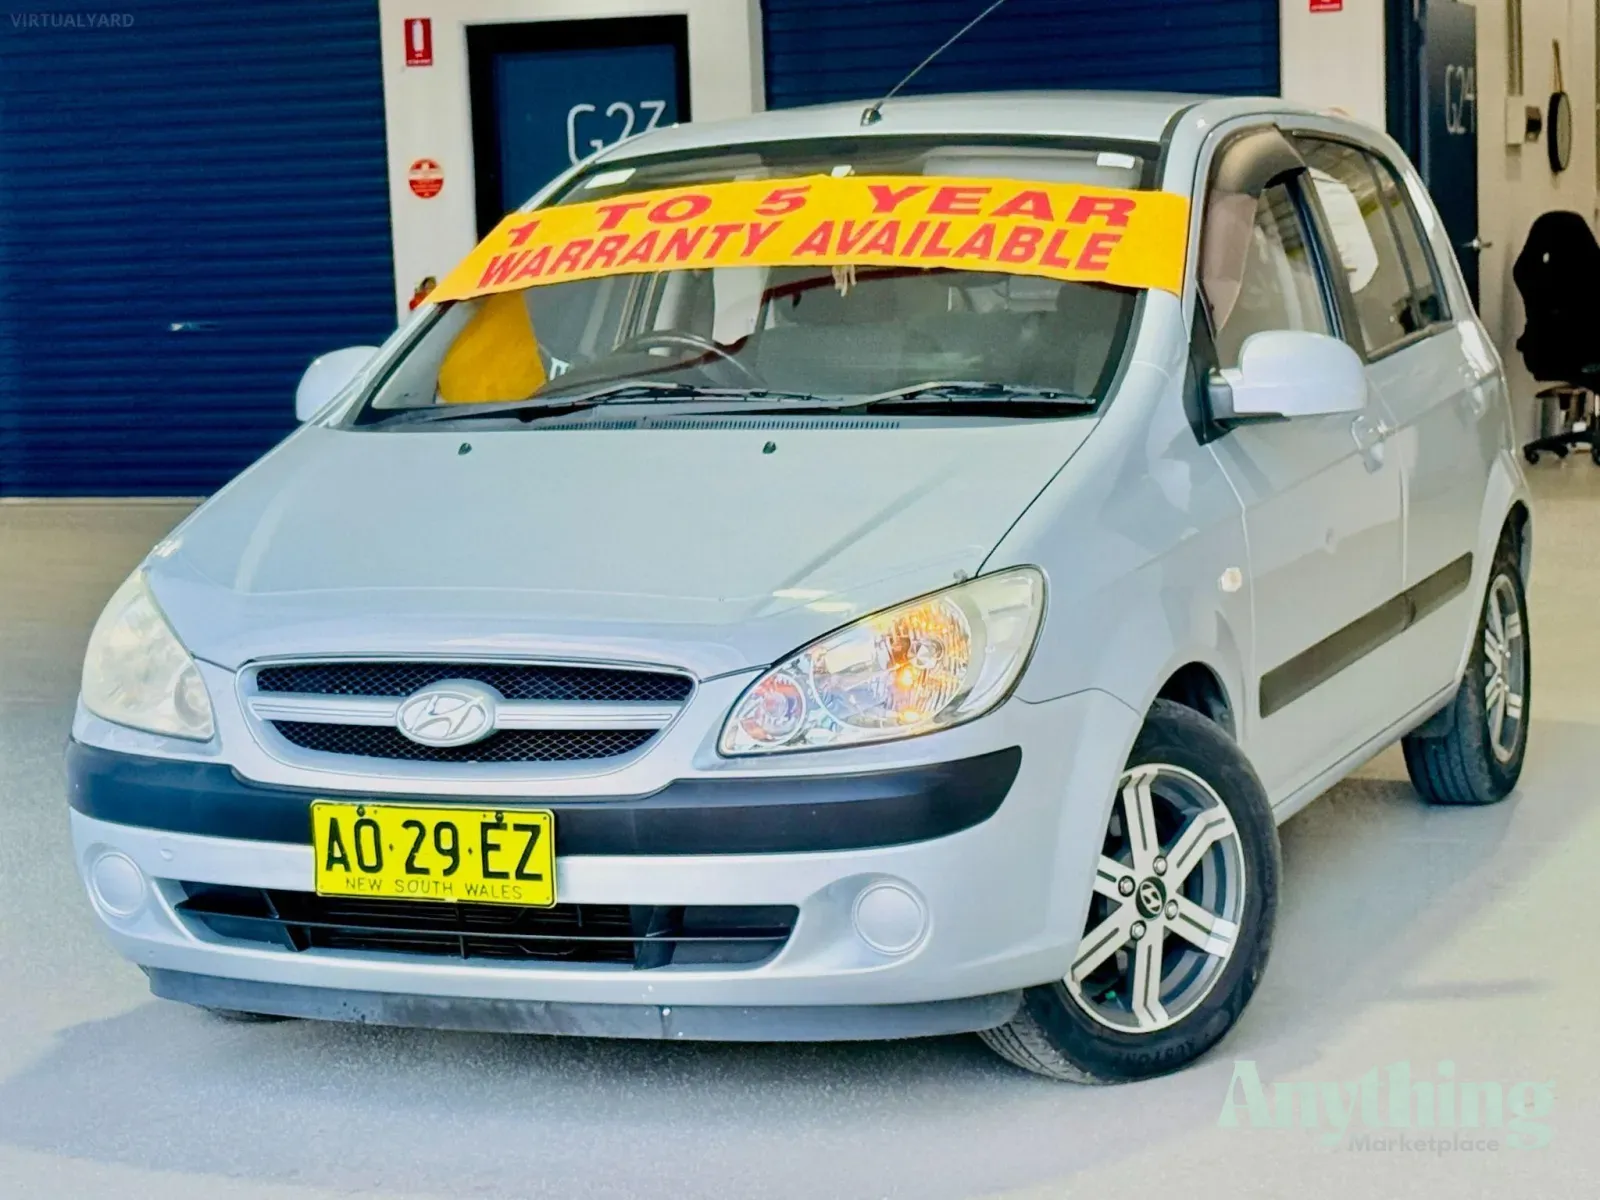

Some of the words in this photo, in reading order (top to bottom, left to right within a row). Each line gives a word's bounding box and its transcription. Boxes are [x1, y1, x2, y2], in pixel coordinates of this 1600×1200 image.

[508, 220, 541, 248] 1
[596, 194, 713, 232] TO
[754, 184, 812, 216] 5
[867, 184, 1137, 228] YEAR
[476, 220, 784, 289] WARRANTY
[791, 219, 1124, 271] AVAILABLE
[345, 877, 383, 893] NEW
[394, 878, 454, 895] SOUTH
[464, 883, 523, 900] WALES
